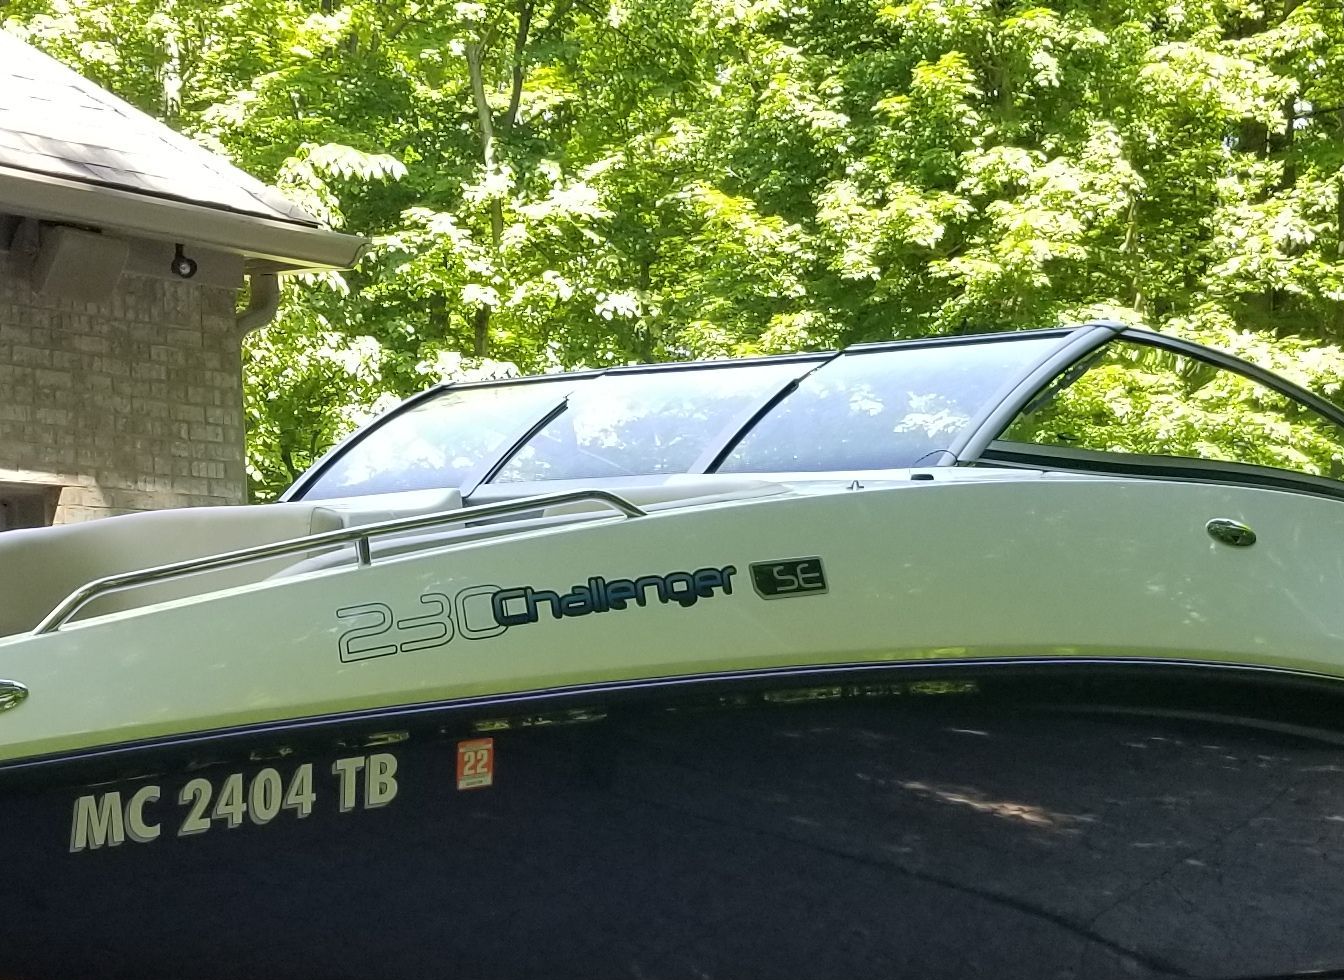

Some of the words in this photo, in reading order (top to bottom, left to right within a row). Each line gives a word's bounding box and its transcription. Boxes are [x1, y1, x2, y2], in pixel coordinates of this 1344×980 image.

[773, 564, 823, 591] SE
[336, 584, 508, 663] 230
[491, 565, 737, 626] Challenger
[463, 749, 489, 776] 22
[70, 785, 161, 852] MC
[177, 763, 317, 837] 2404
[332, 752, 399, 810] TB
